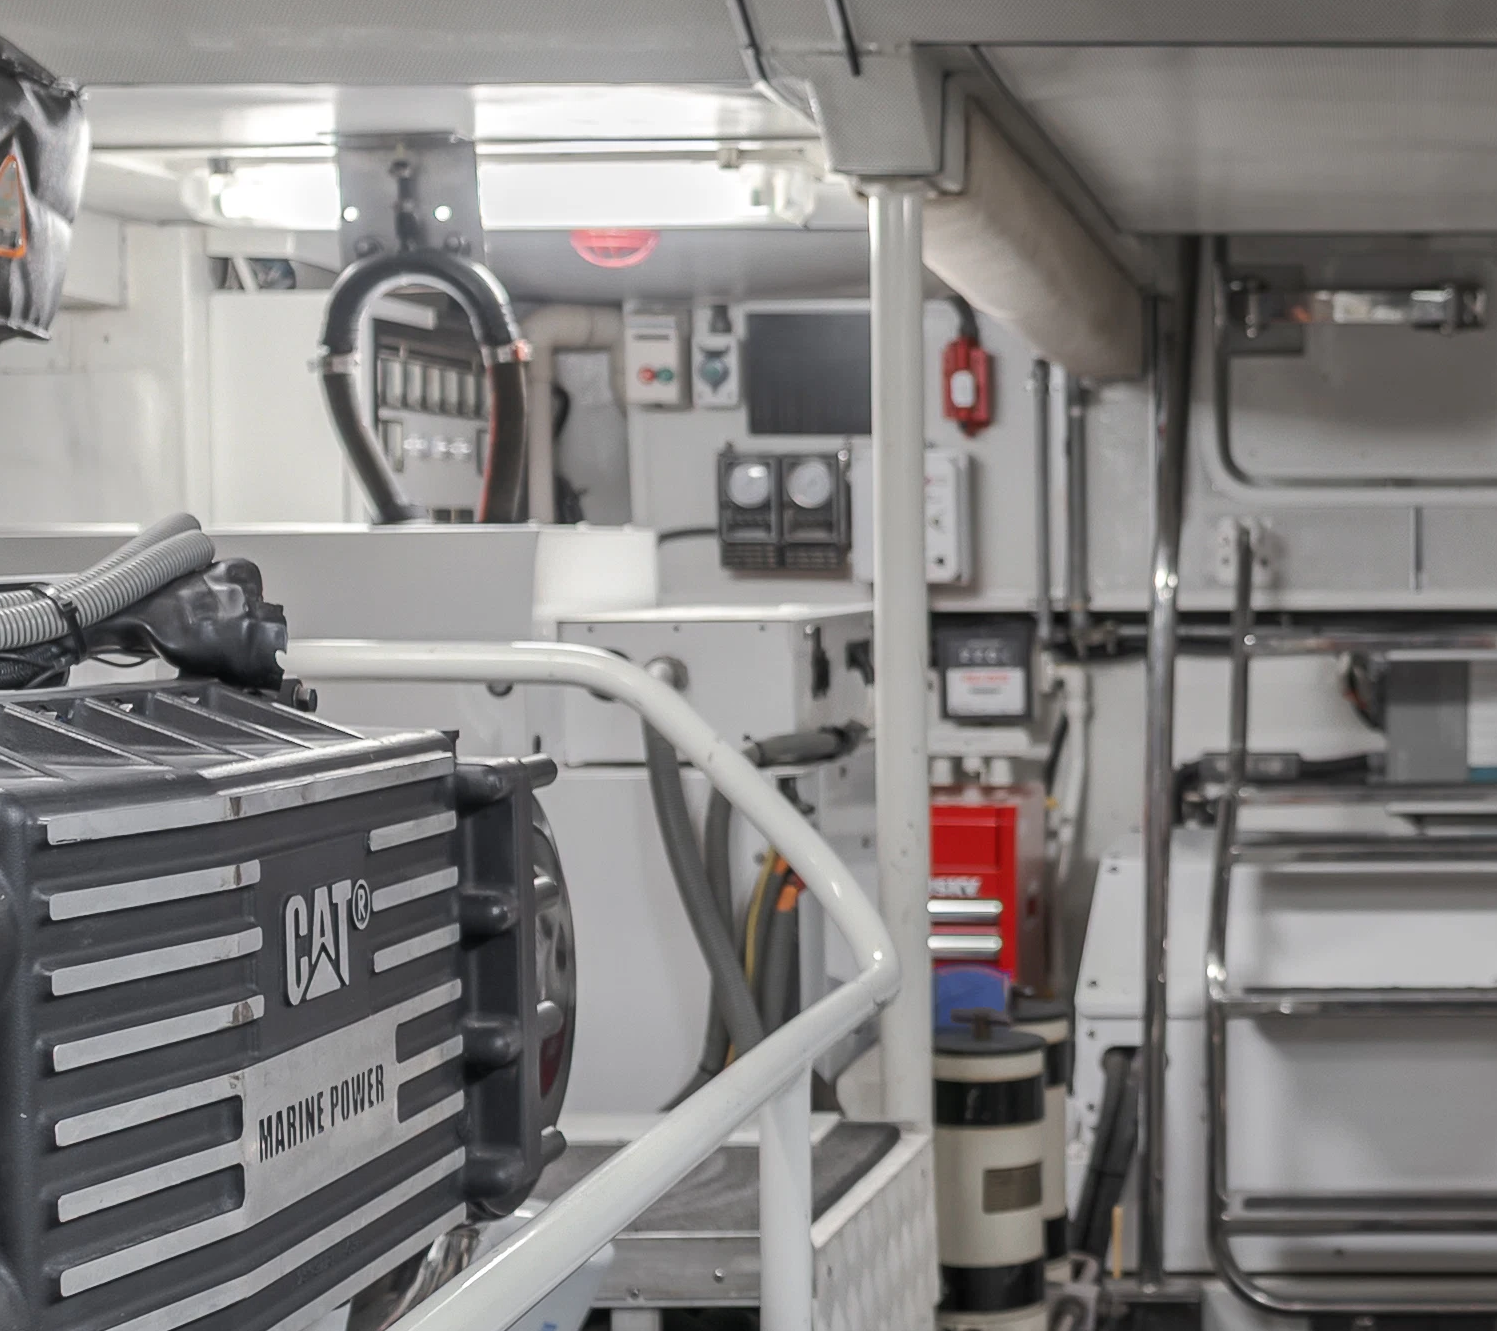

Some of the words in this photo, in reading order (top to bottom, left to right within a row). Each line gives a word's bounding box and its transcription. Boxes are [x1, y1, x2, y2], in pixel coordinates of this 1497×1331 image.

[286, 879, 352, 1006] CAT
[259, 1092, 325, 1163] MARINE
[330, 1064, 385, 1127] POWER
